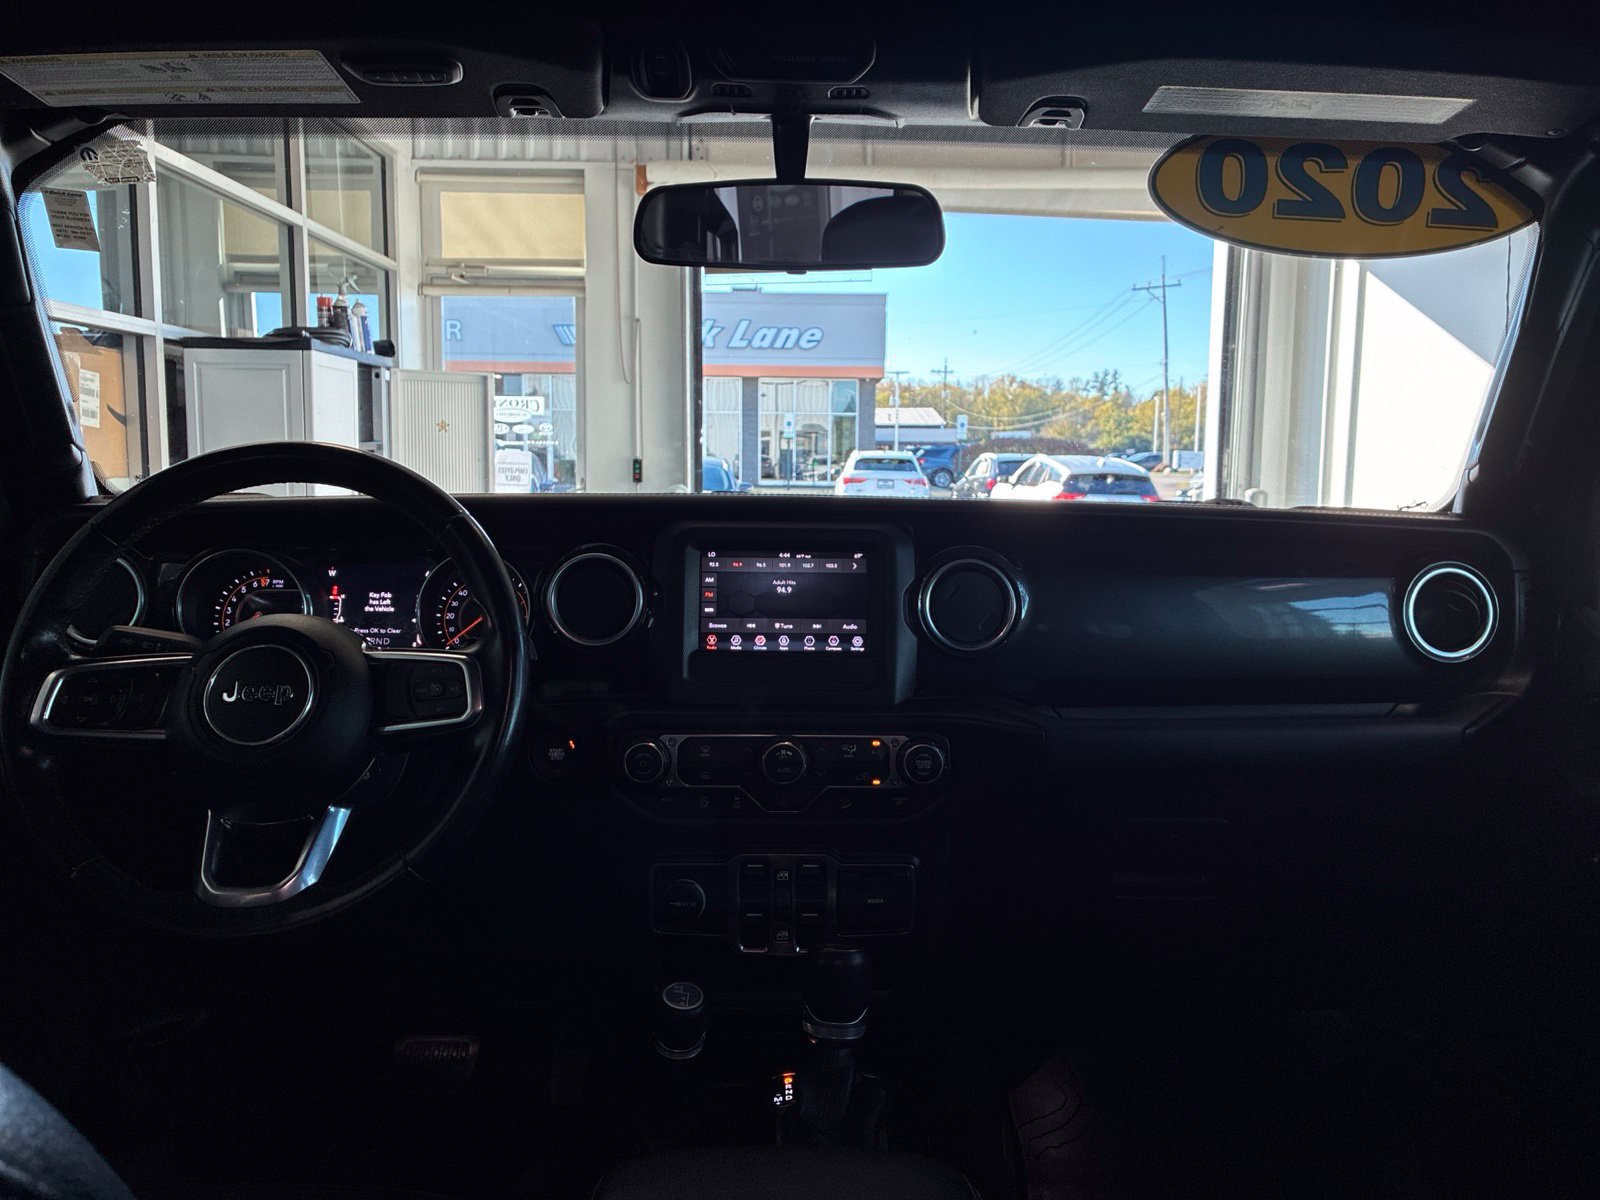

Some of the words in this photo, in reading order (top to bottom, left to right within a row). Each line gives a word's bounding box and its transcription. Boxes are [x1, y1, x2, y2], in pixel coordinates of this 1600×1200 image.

[727, 318, 824, 350] Lane
[458, 589, 468, 597] 40
[776, 586, 792, 594] 94.9
[369, 592, 380, 600] Key
[446, 612, 455, 620] 20
[225, 619, 231, 627] 2
[221, 680, 294, 706] Jeep
